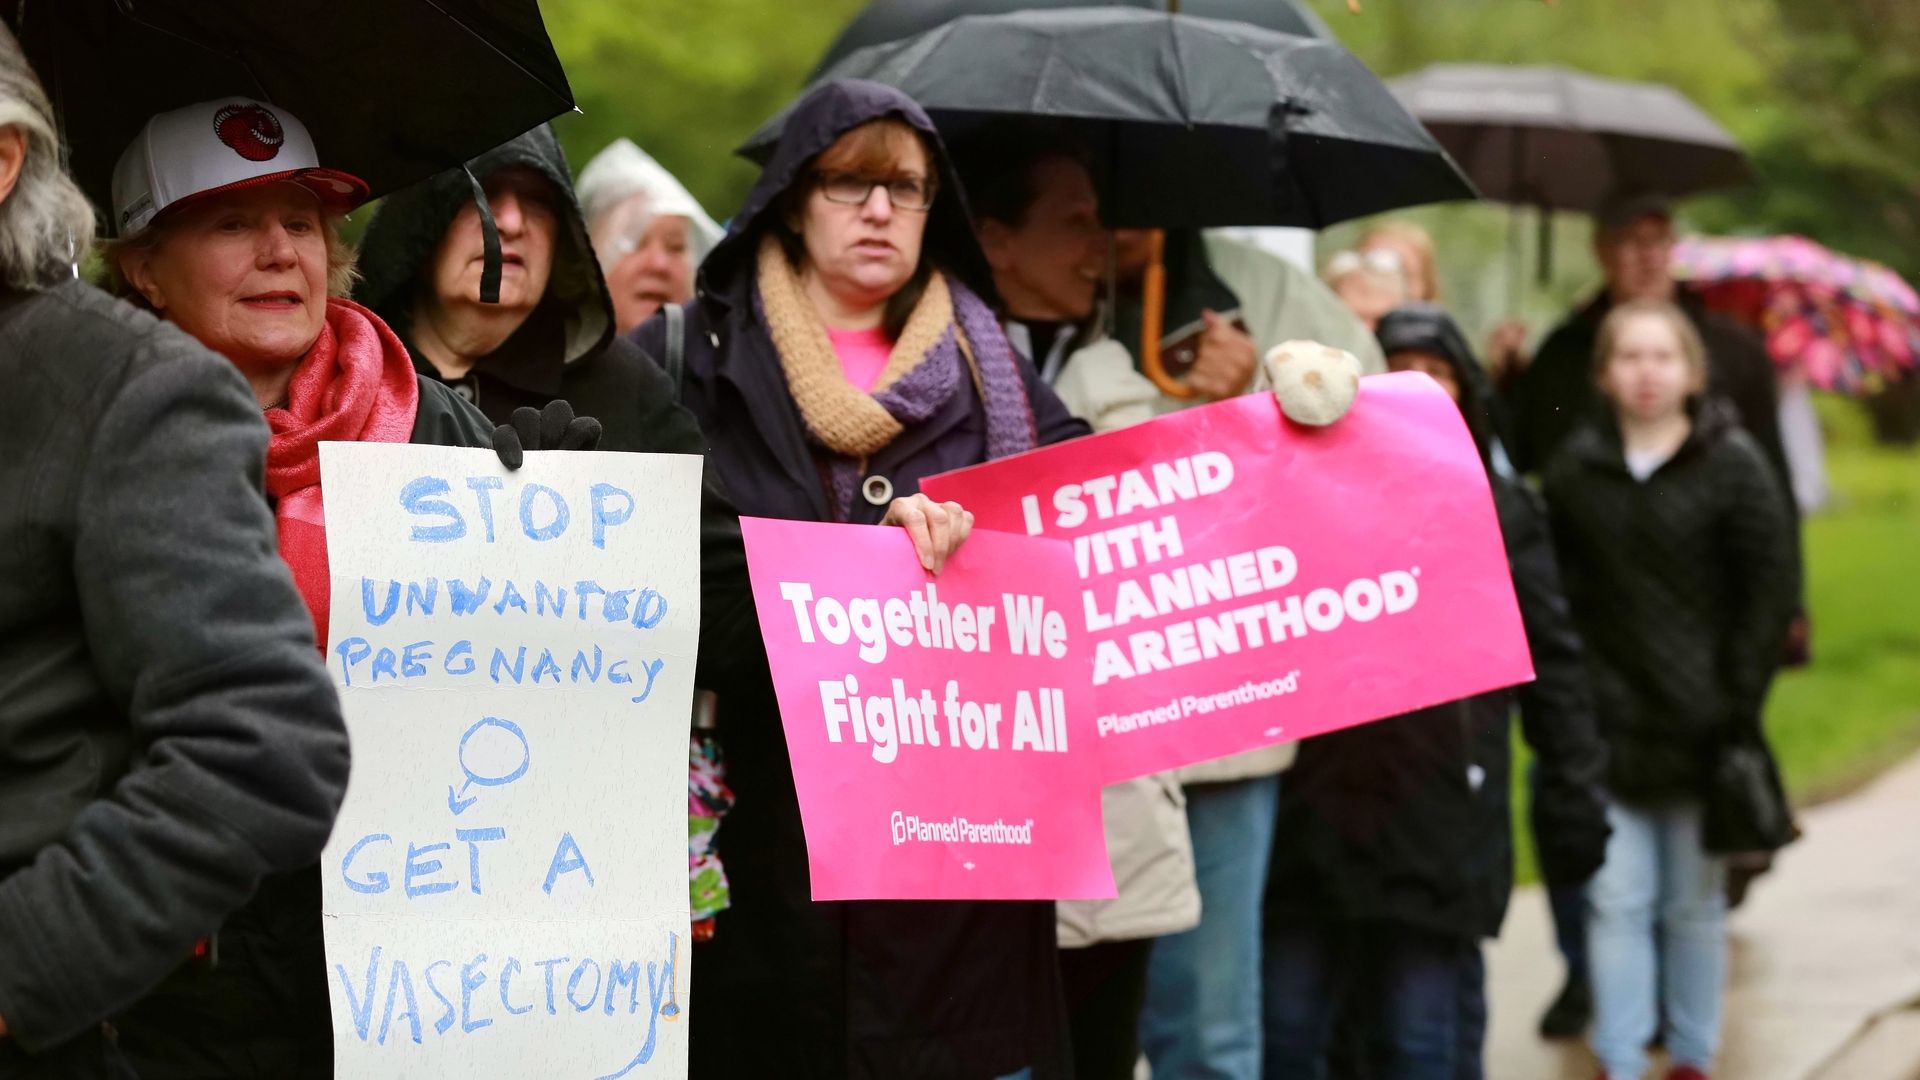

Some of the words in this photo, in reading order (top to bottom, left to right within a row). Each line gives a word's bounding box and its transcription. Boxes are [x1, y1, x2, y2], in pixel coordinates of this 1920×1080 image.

[399, 475, 636, 550] STOP
[1021, 494, 1044, 536] I
[1054, 451, 1234, 529] STAND
[361, 575, 669, 631] UNWANTED
[778, 580, 997, 666] Together
[1002, 591, 1069, 660] We
[1081, 545, 1298, 632] LANNED
[1091, 569, 1419, 686] ARENTHOOD
[335, 634, 666, 705] PREGNANCY
[1097, 695, 1182, 738] Planned
[1182, 671, 1299, 718] Parenthood
[817, 673, 940, 765] Fight
[942, 679, 1002, 751] for
[1011, 686, 1069, 754] All
[341, 825, 507, 900] GET
[541, 831, 595, 895] A
[906, 815, 957, 843] Planned
[959, 816, 1034, 845] Parenthood
